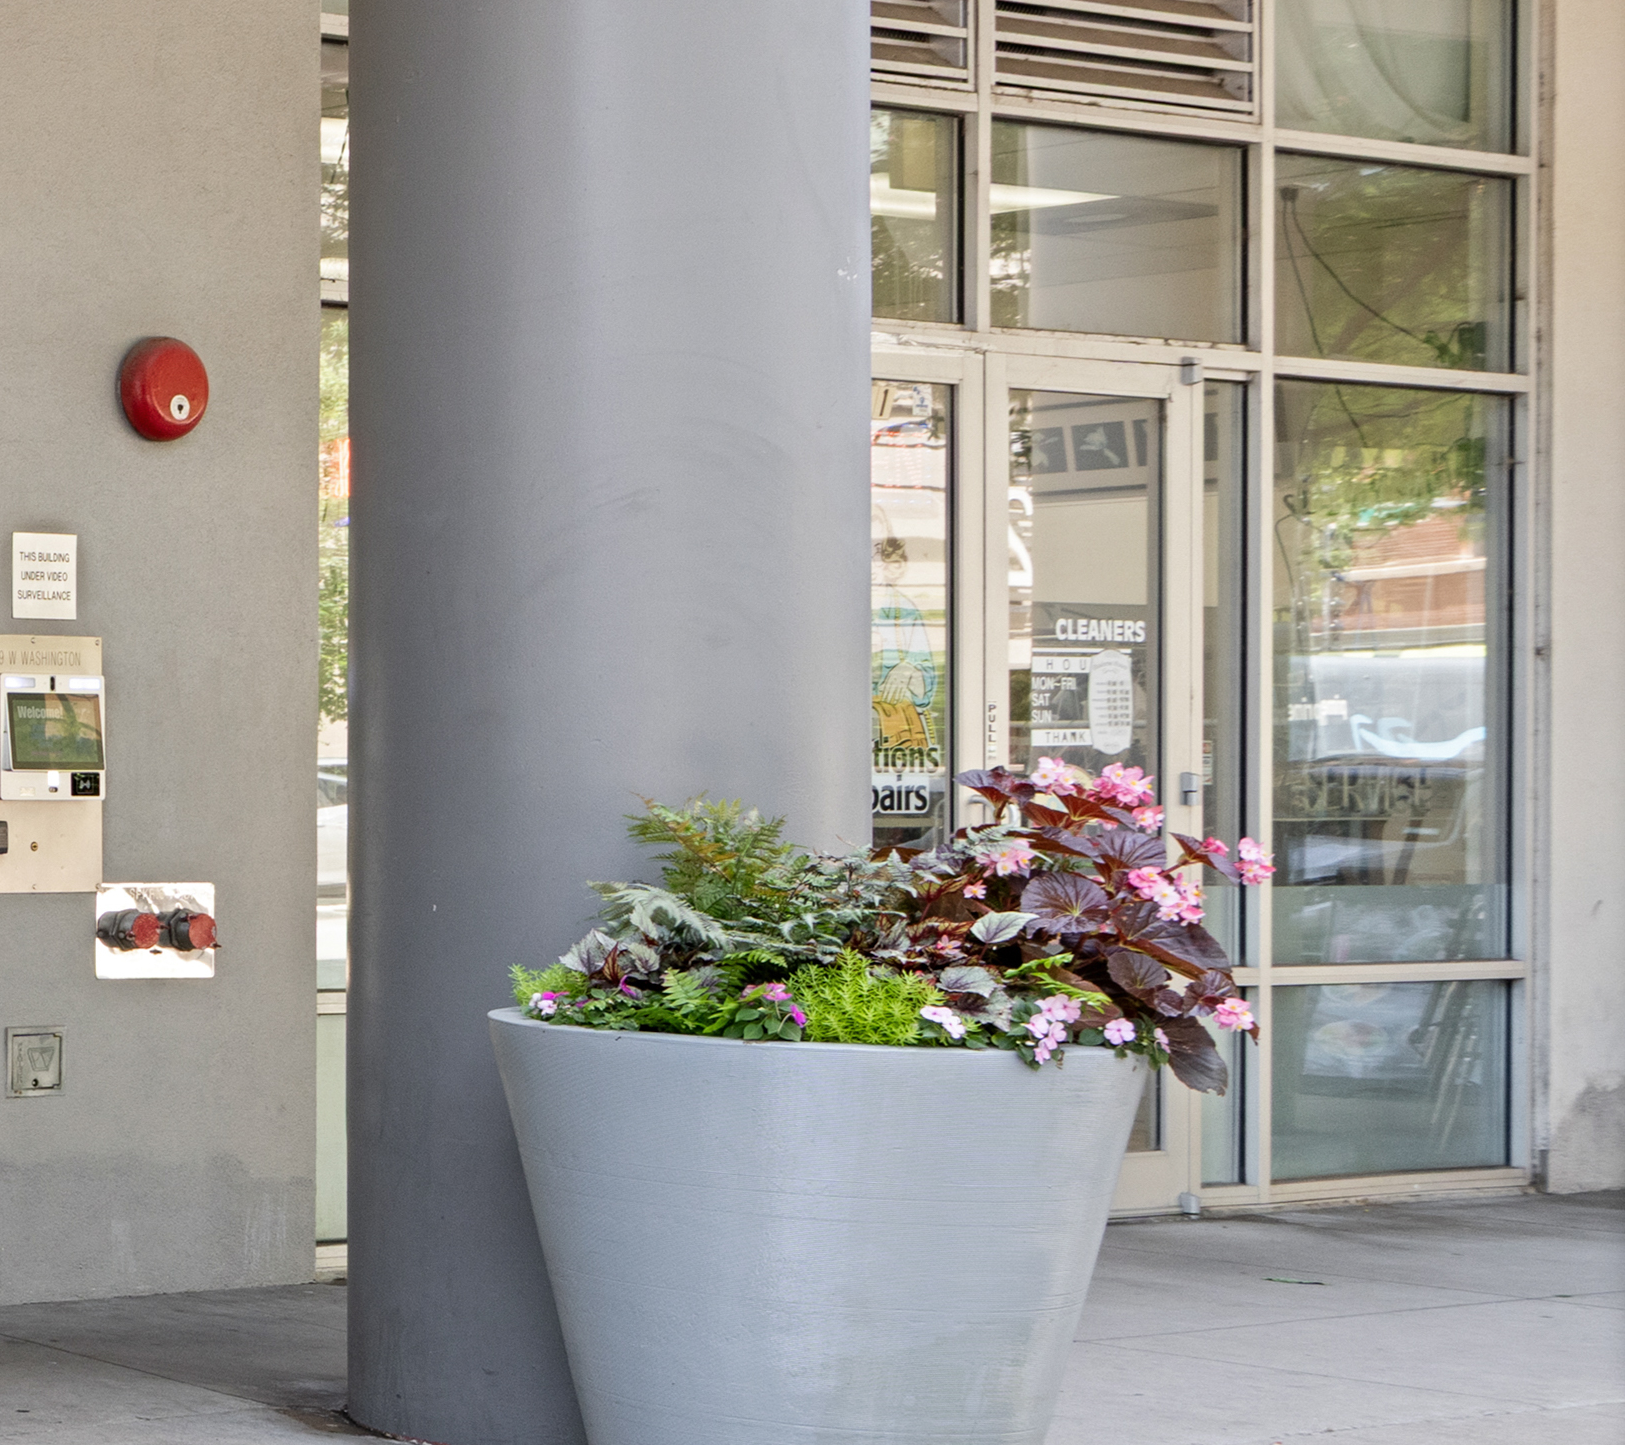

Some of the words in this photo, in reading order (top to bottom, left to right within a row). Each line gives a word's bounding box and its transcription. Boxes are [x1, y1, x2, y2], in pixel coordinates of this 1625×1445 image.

[19, 551, 37, 562] THIS
[38, 552, 70, 563] BUILDING
[20, 571, 45, 581] UNDER
[46, 572, 68, 581] VIDEO
[17, 590, 71, 600] SURVEILLANCE
[1055, 618, 1146, 642] CLEANERS
[8, 650, 17, 665] W
[21, 651, 81, 666] WASHINGTON
[1031, 693, 1050, 707] SAT
[17, 706, 63, 719] Welcome!
[1031, 710, 1052, 723] SUN
[988, 704, 997, 743] PULL
[1045, 732, 1086, 744] THANK
